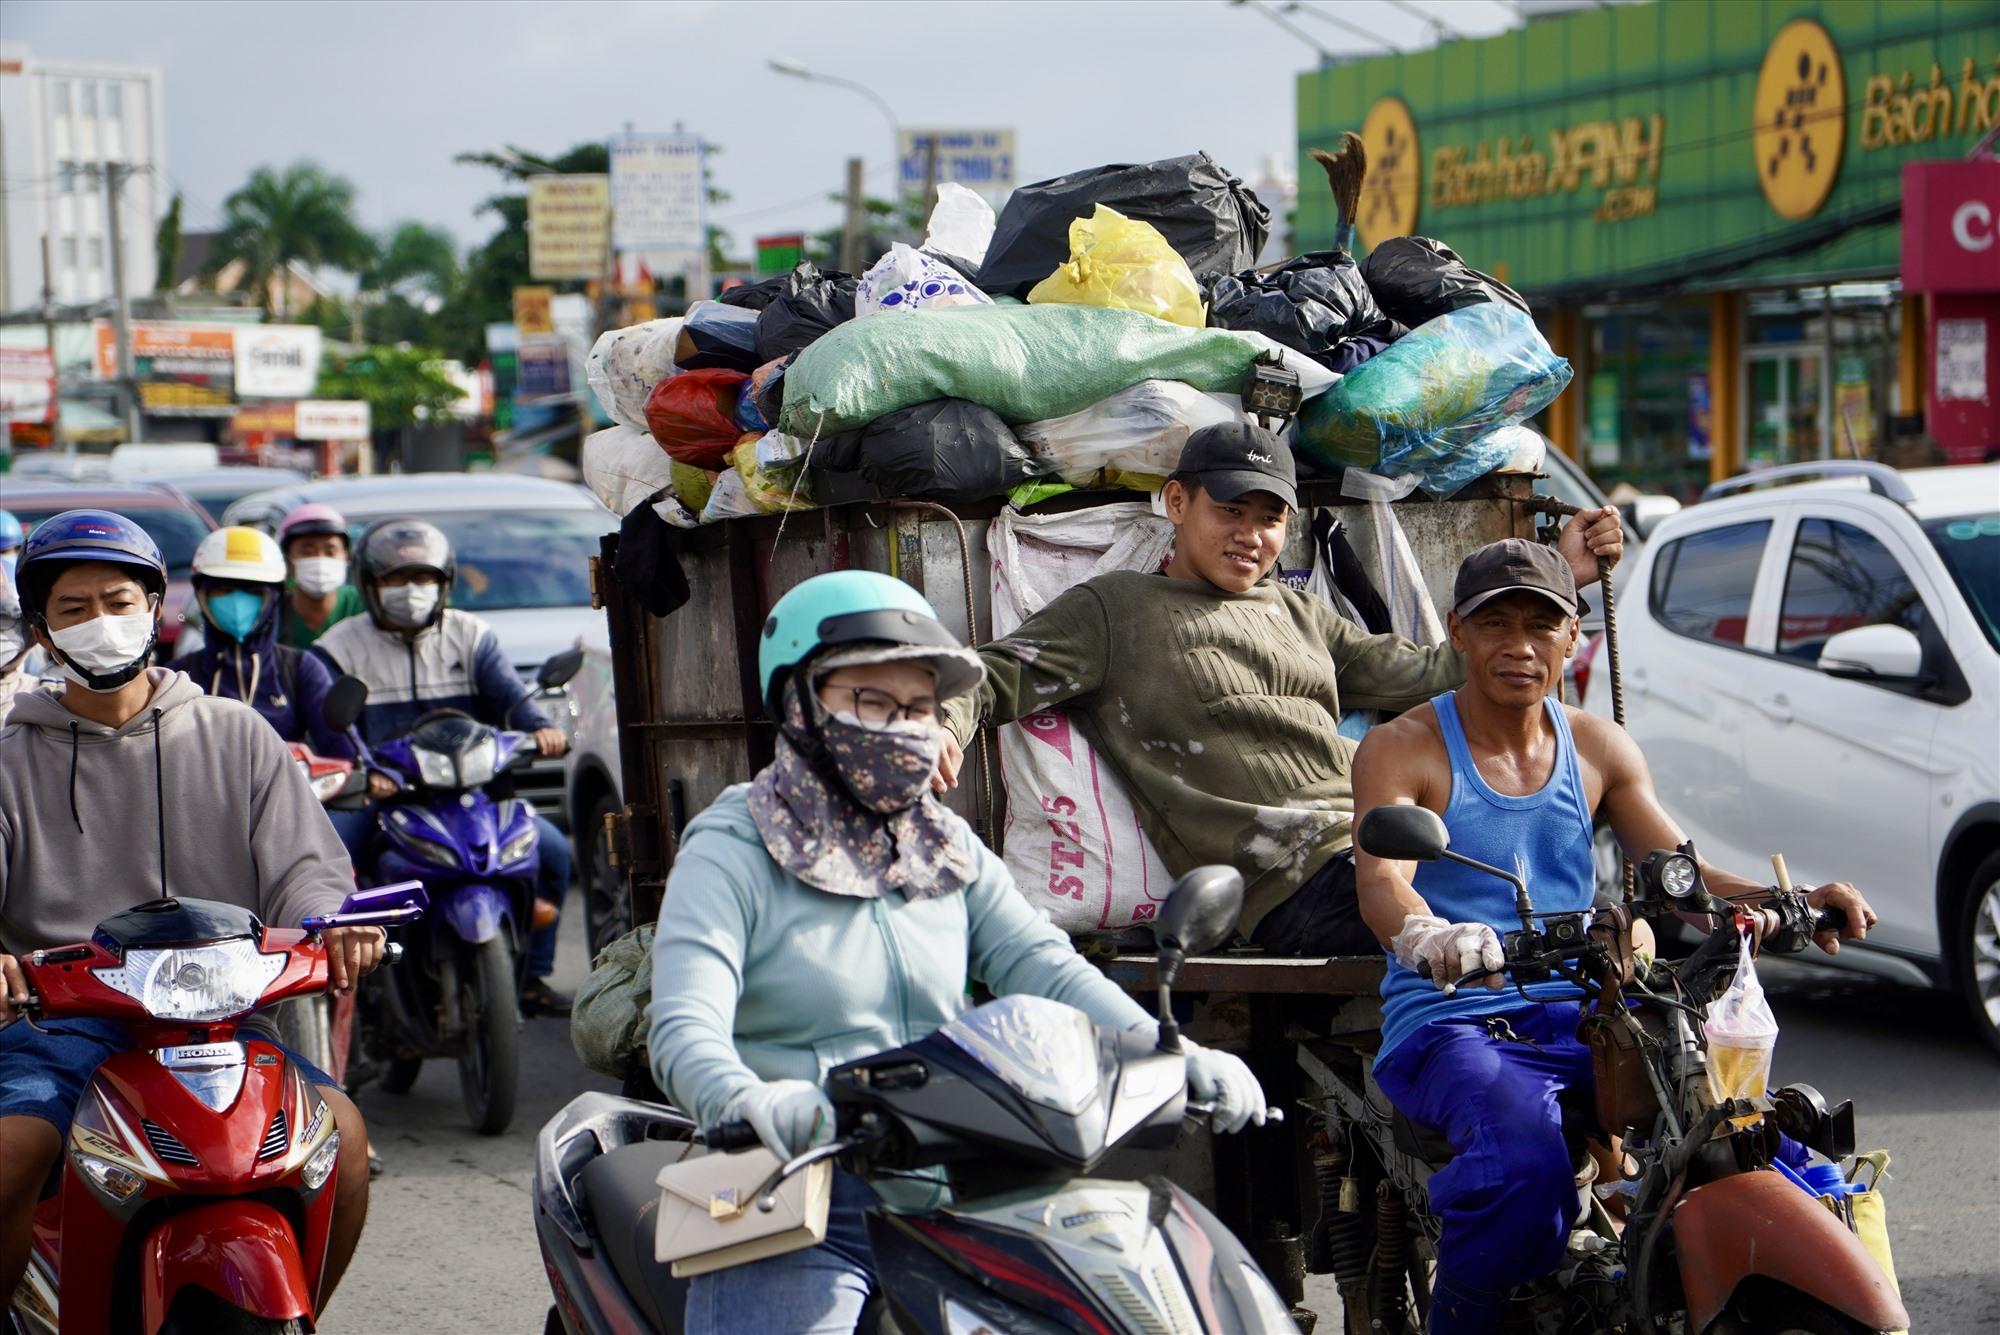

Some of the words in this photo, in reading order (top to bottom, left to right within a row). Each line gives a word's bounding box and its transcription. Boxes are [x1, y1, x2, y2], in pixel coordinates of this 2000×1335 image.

[1861, 63, 1952, 149] Bách
[1547, 113, 1665, 192] XANH
[1952, 201, 2000, 253] C
[1042, 795, 1085, 901] ST25
[178, 1047, 233, 1060] HONDA
